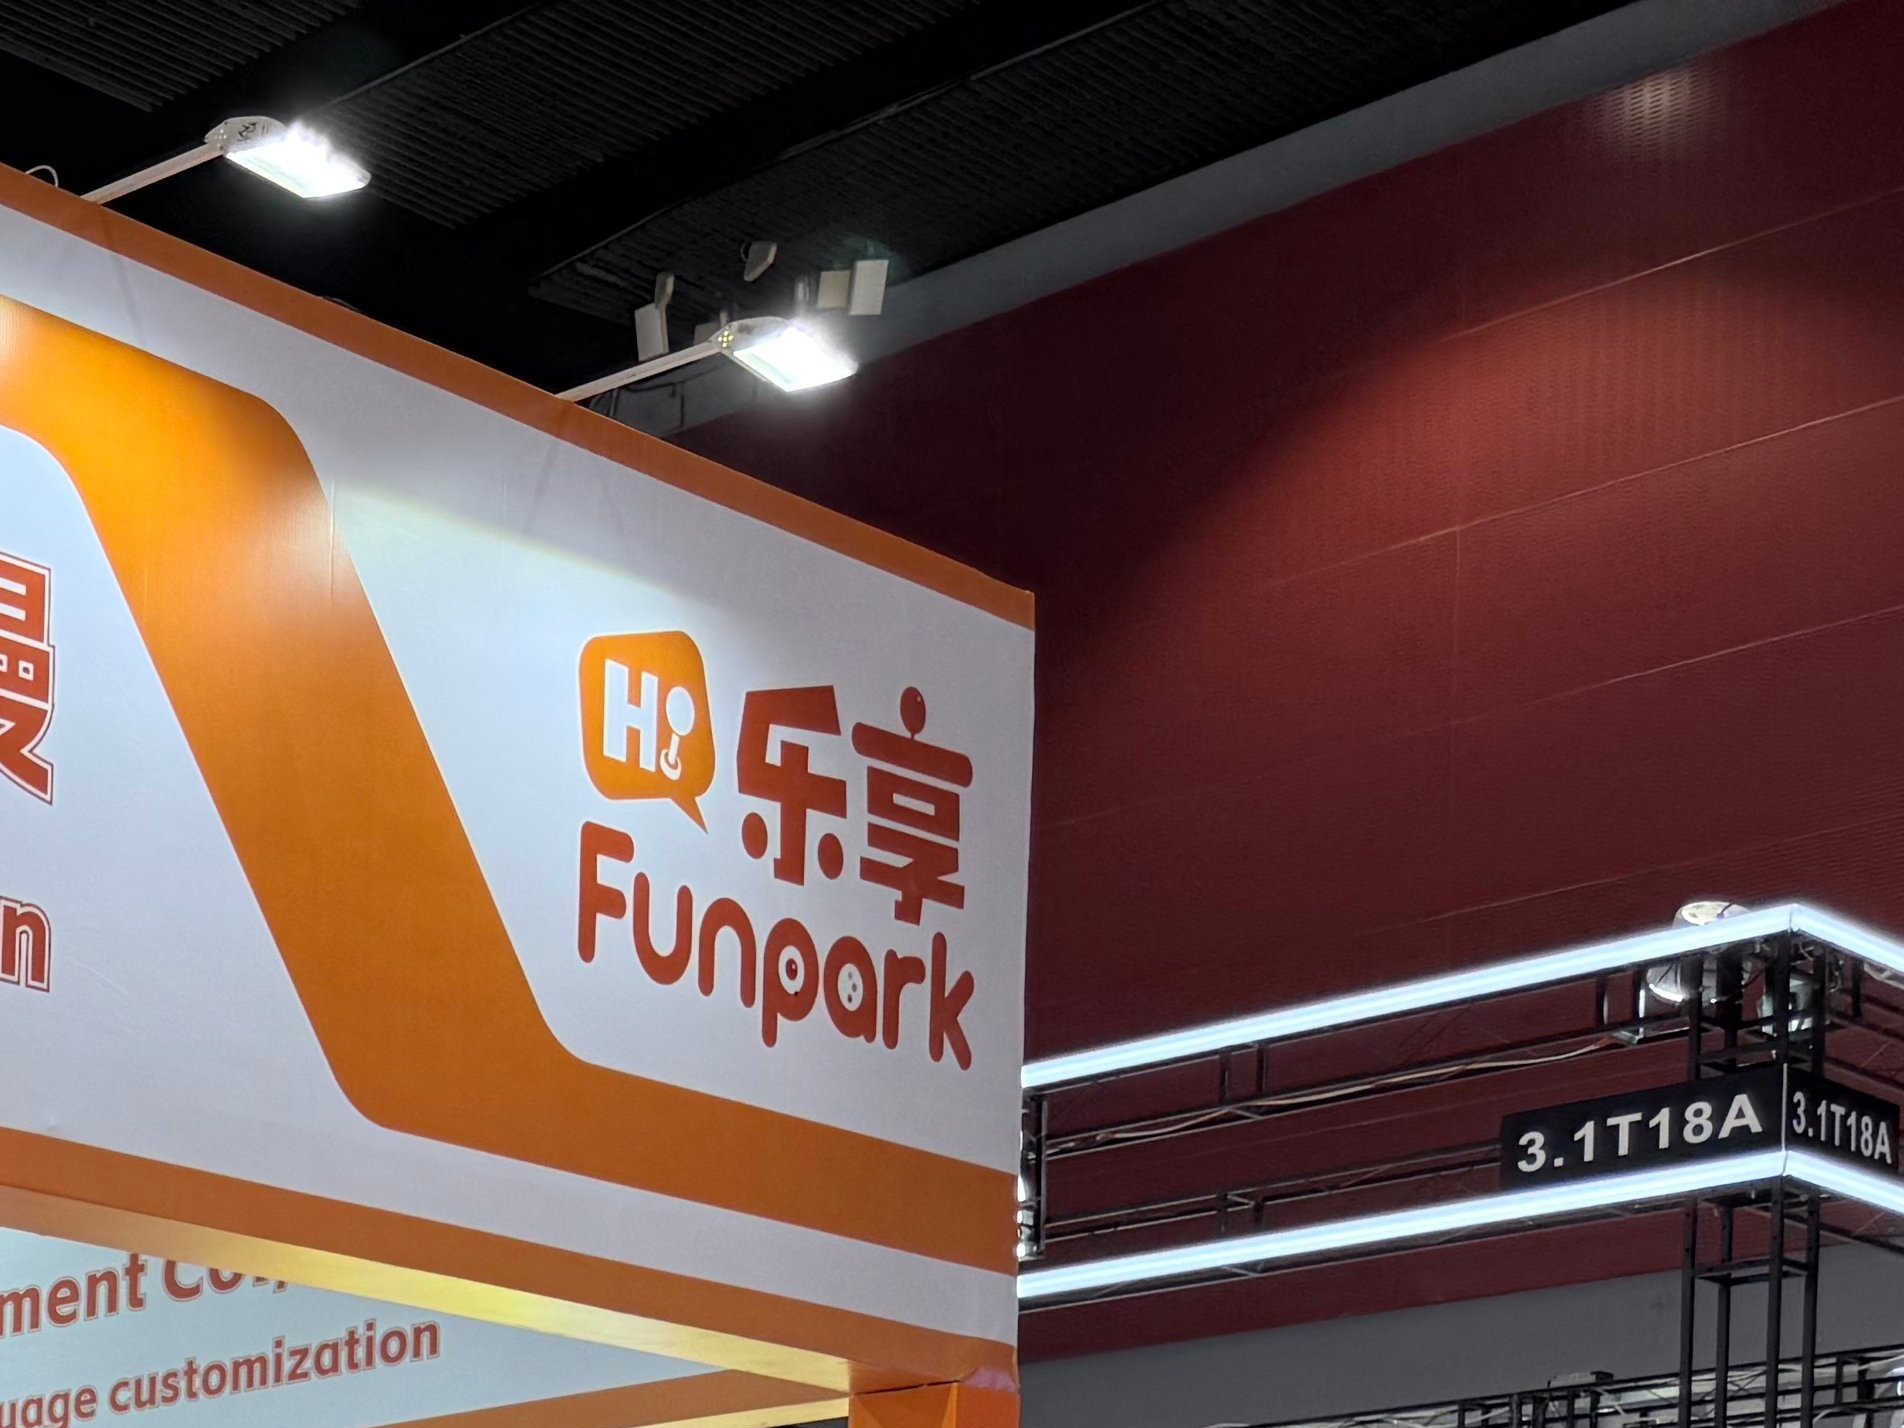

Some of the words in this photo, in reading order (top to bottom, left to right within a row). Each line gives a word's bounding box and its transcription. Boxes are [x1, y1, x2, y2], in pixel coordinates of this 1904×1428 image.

[737, 685, 973, 926] 乐享
[578, 820, 975, 1071] Funpark
[1516, 1093, 1764, 1173] 3.1T18A
[1792, 1090, 1893, 1165] 3.1T18A
[107, 1317, 442, 1414] customization
